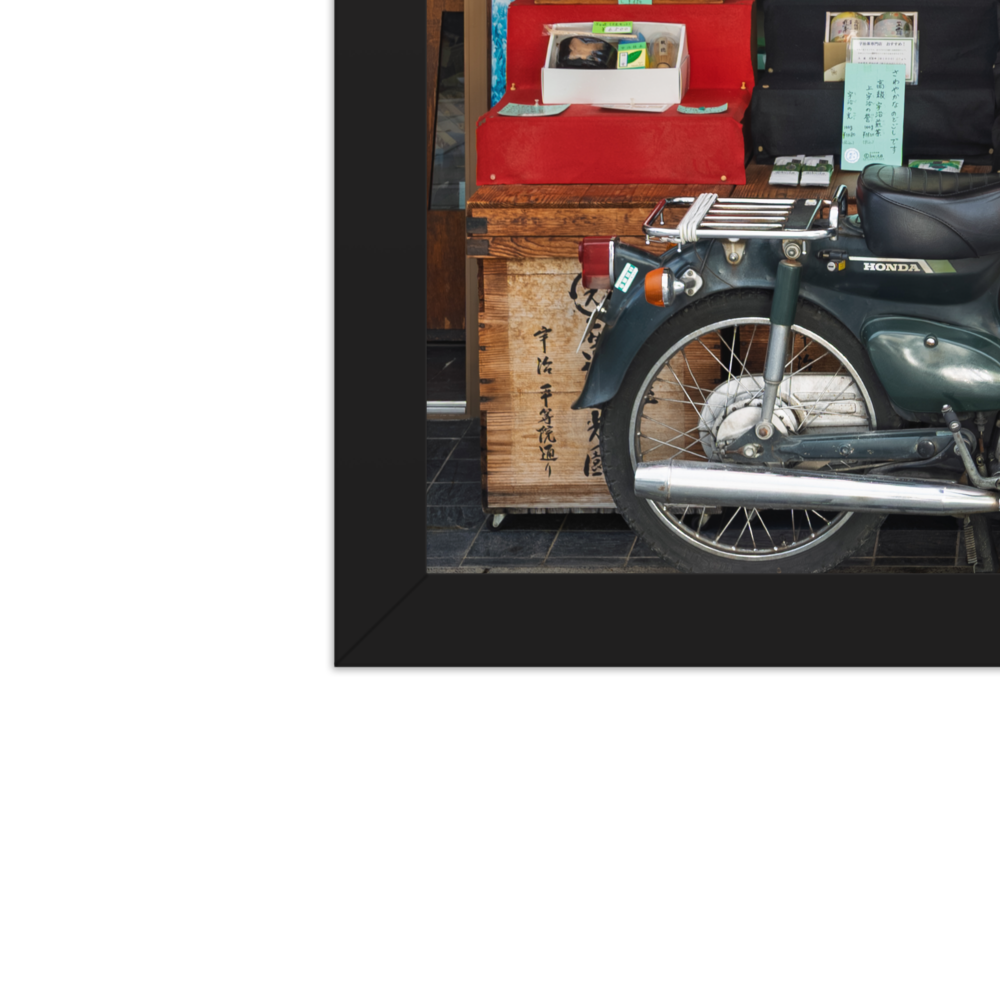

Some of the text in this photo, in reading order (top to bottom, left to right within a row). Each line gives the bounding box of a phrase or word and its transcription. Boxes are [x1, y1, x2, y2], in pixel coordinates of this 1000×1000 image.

[863, 262, 921, 272] HONDA
[533, 326, 558, 478] 宇治 平等院通り
